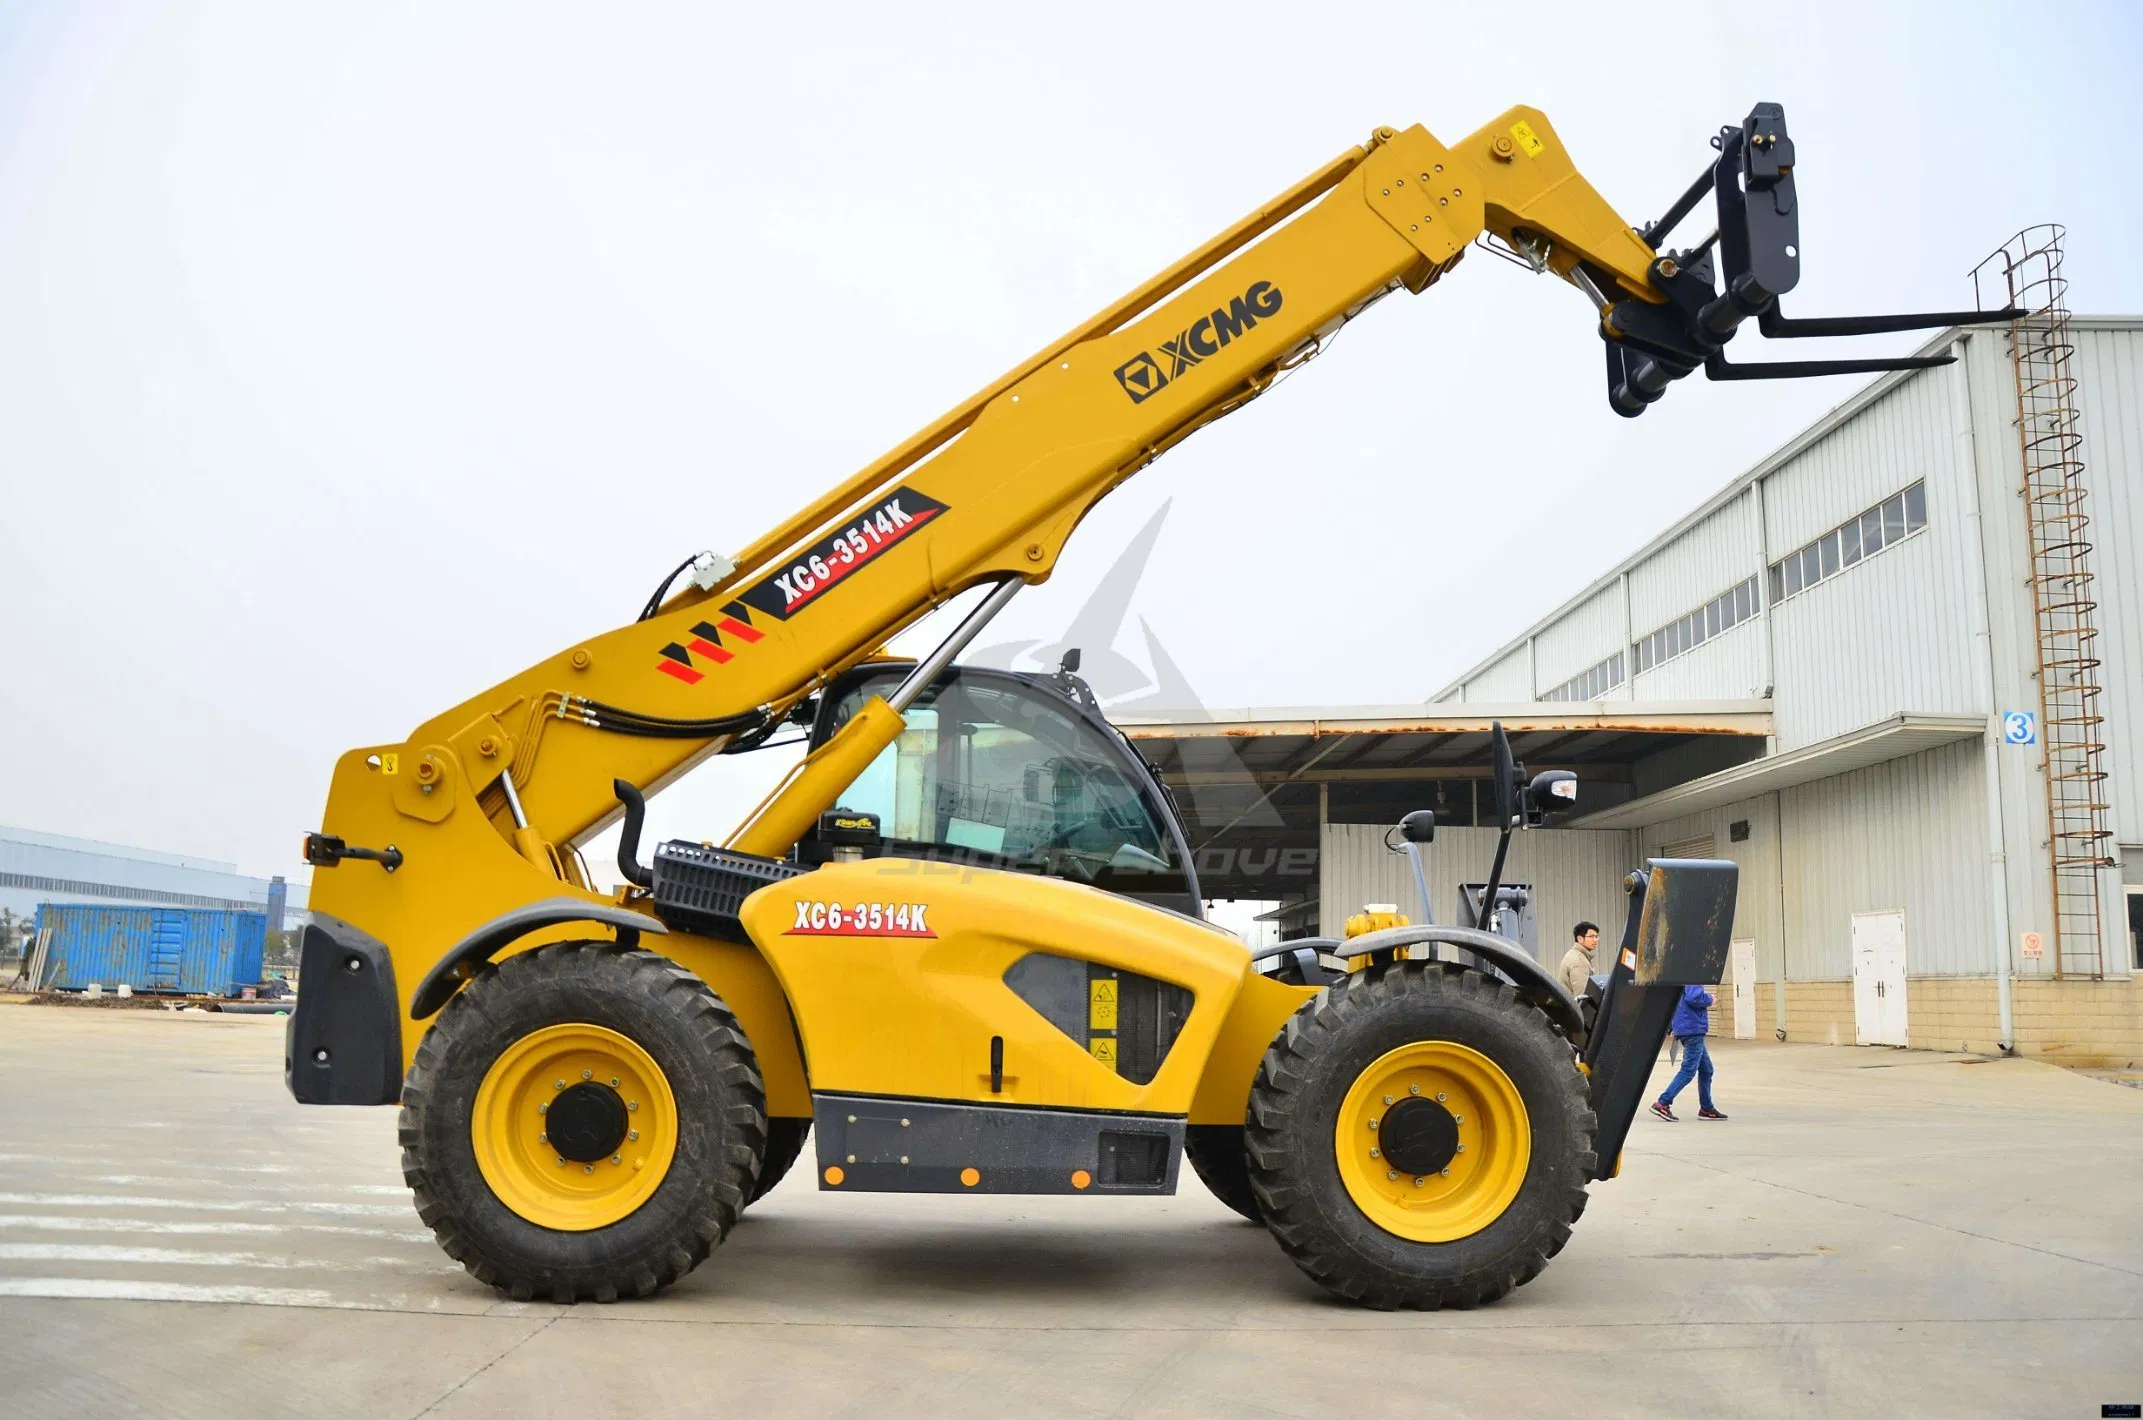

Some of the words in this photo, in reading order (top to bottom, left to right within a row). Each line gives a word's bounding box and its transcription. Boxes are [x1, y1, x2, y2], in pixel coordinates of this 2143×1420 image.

[1157, 280, 1283, 382] XCMG
[774, 498, 913, 605] XC6-3514K
[2012, 715, 2028, 740] 3
[794, 901, 928, 932] XC6-3514K
